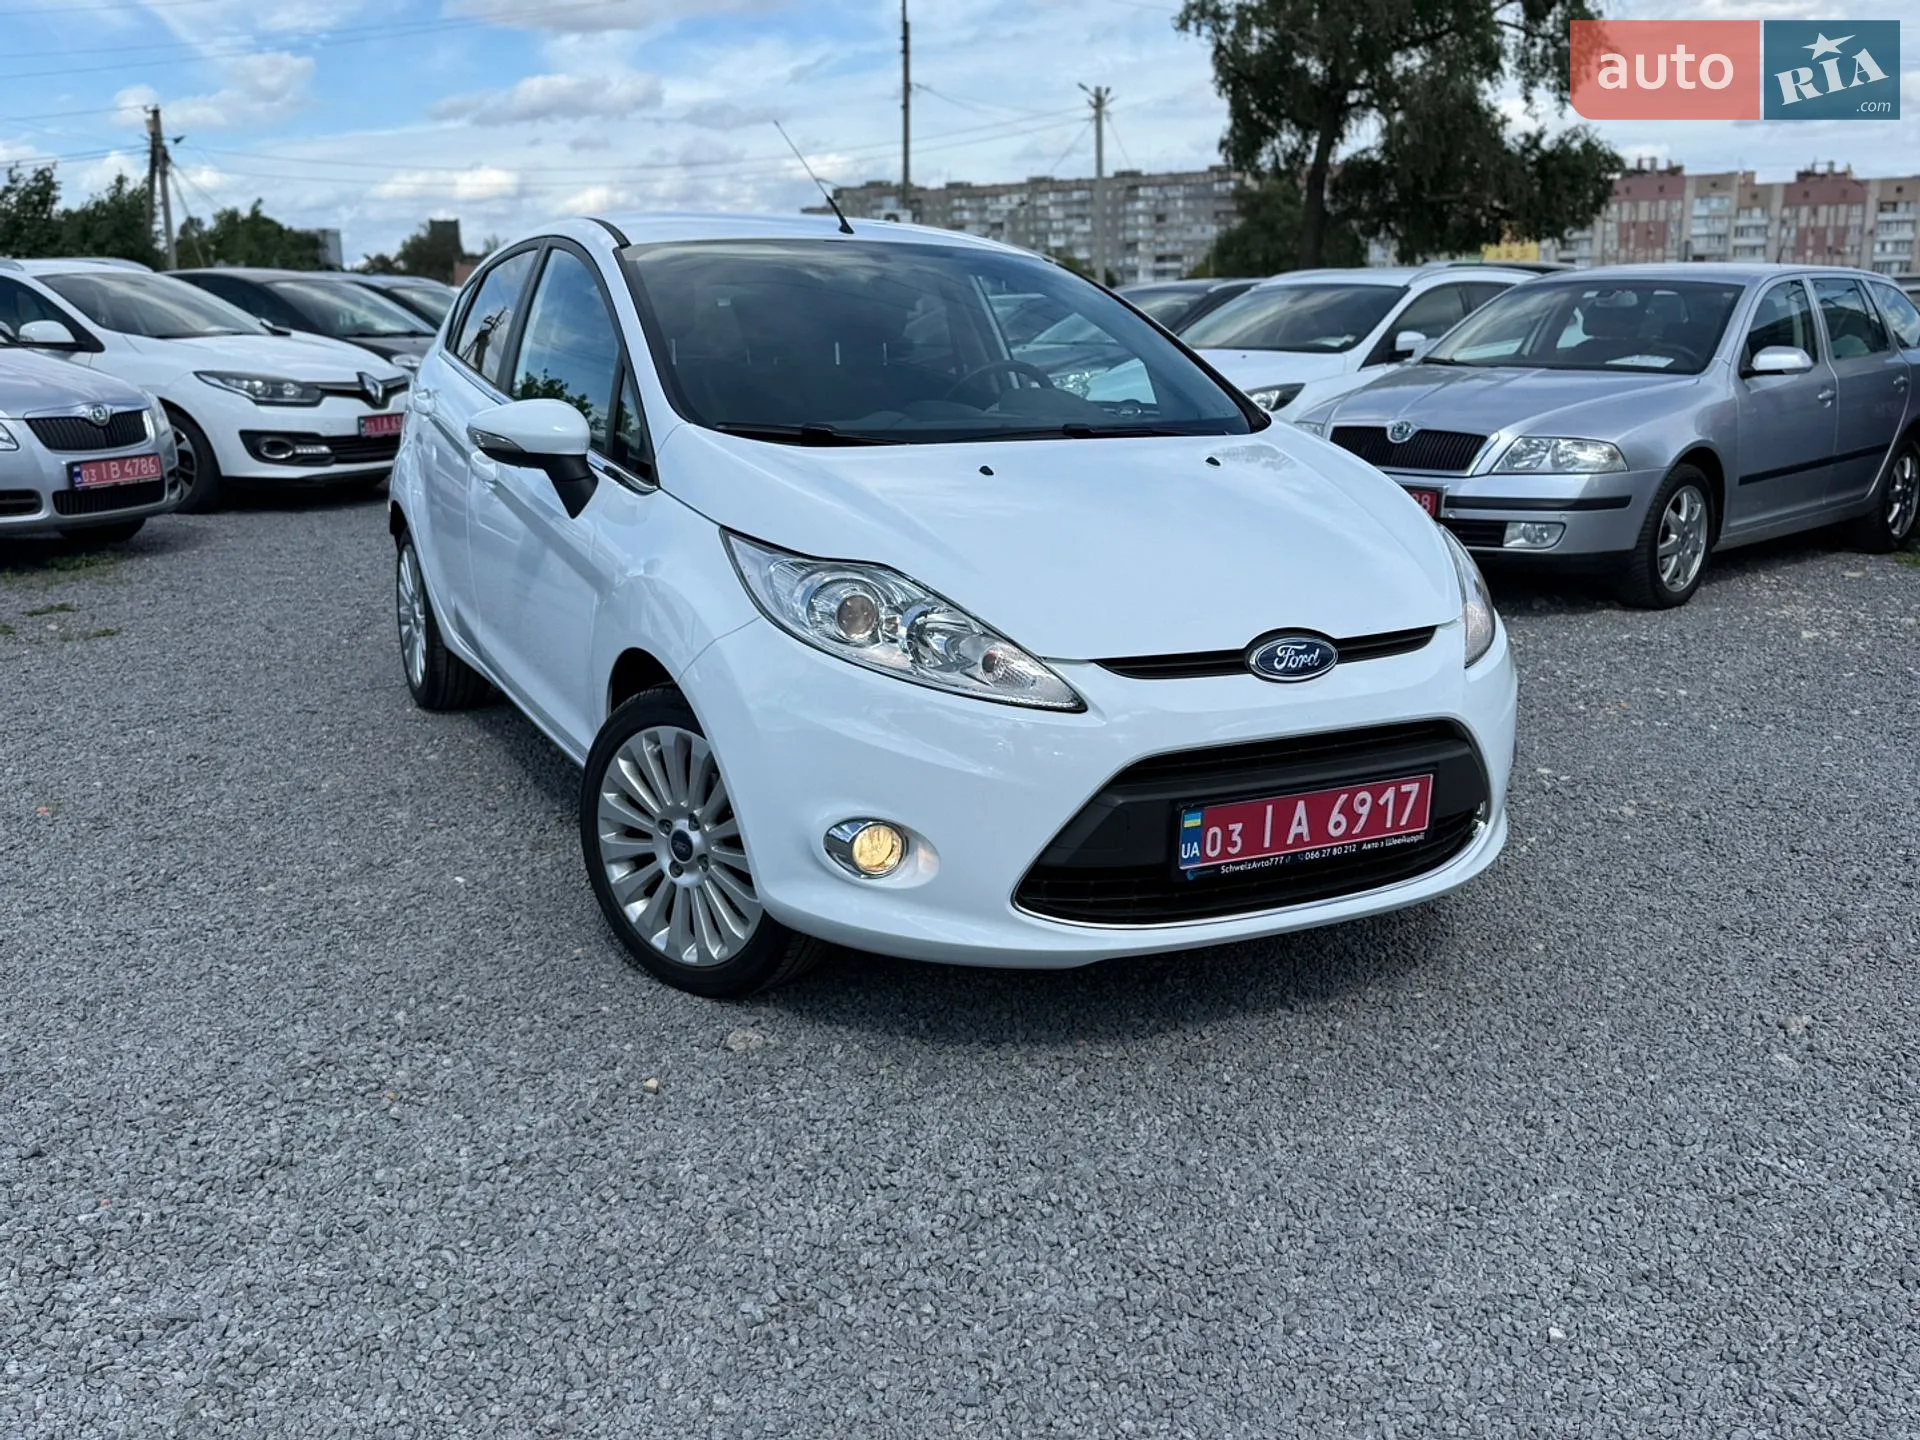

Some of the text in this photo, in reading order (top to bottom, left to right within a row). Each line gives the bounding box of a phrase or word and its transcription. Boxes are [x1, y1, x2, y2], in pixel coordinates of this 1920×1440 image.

[82, 469, 97, 482] 03
[101, 462, 120, 479] IB
[124, 457, 156, 476] 4786
[1274, 644, 1320, 670] Ford
[1206, 782, 1420, 857] 03 IA 6917
[1181, 842, 1199, 859] UA
[1304, 850, 1320, 860] 066
[1321, 847, 1330, 857] 27
[1344, 844, 1357, 853] 212
